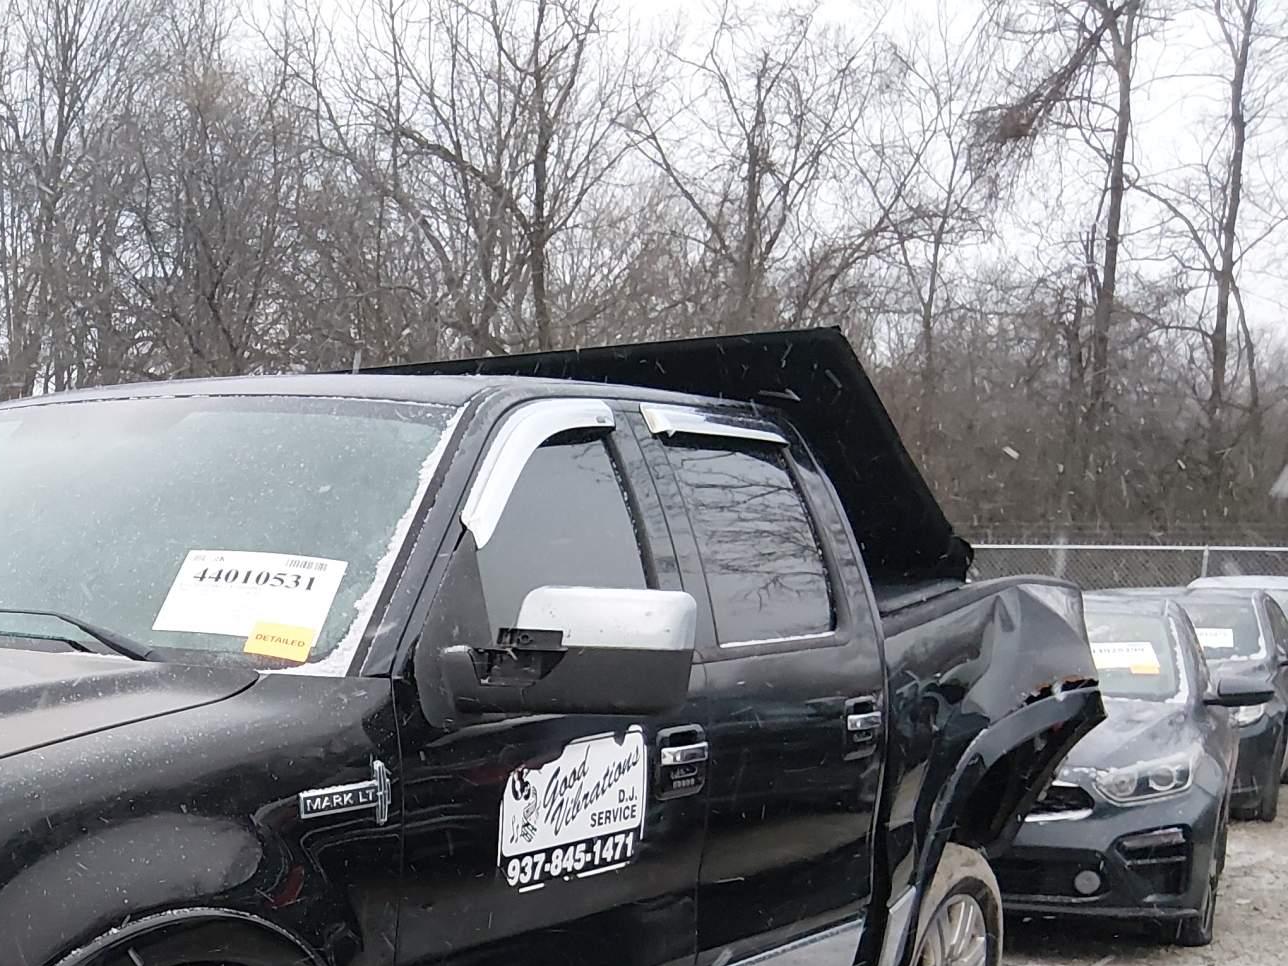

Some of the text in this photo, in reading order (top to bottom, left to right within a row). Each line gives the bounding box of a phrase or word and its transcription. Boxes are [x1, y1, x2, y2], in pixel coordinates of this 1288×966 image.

[193, 567, 316, 591] 44010531
[255, 633, 305, 648] DETAILED
[543, 743, 591, 809] Good
[306, 789, 375, 811] MARK LT
[544, 745, 640, 836] Vibrations
[618, 786, 638, 804] D.J.
[590, 804, 637, 828] SERVICE
[507, 832, 634, 887] 937-845-1471
